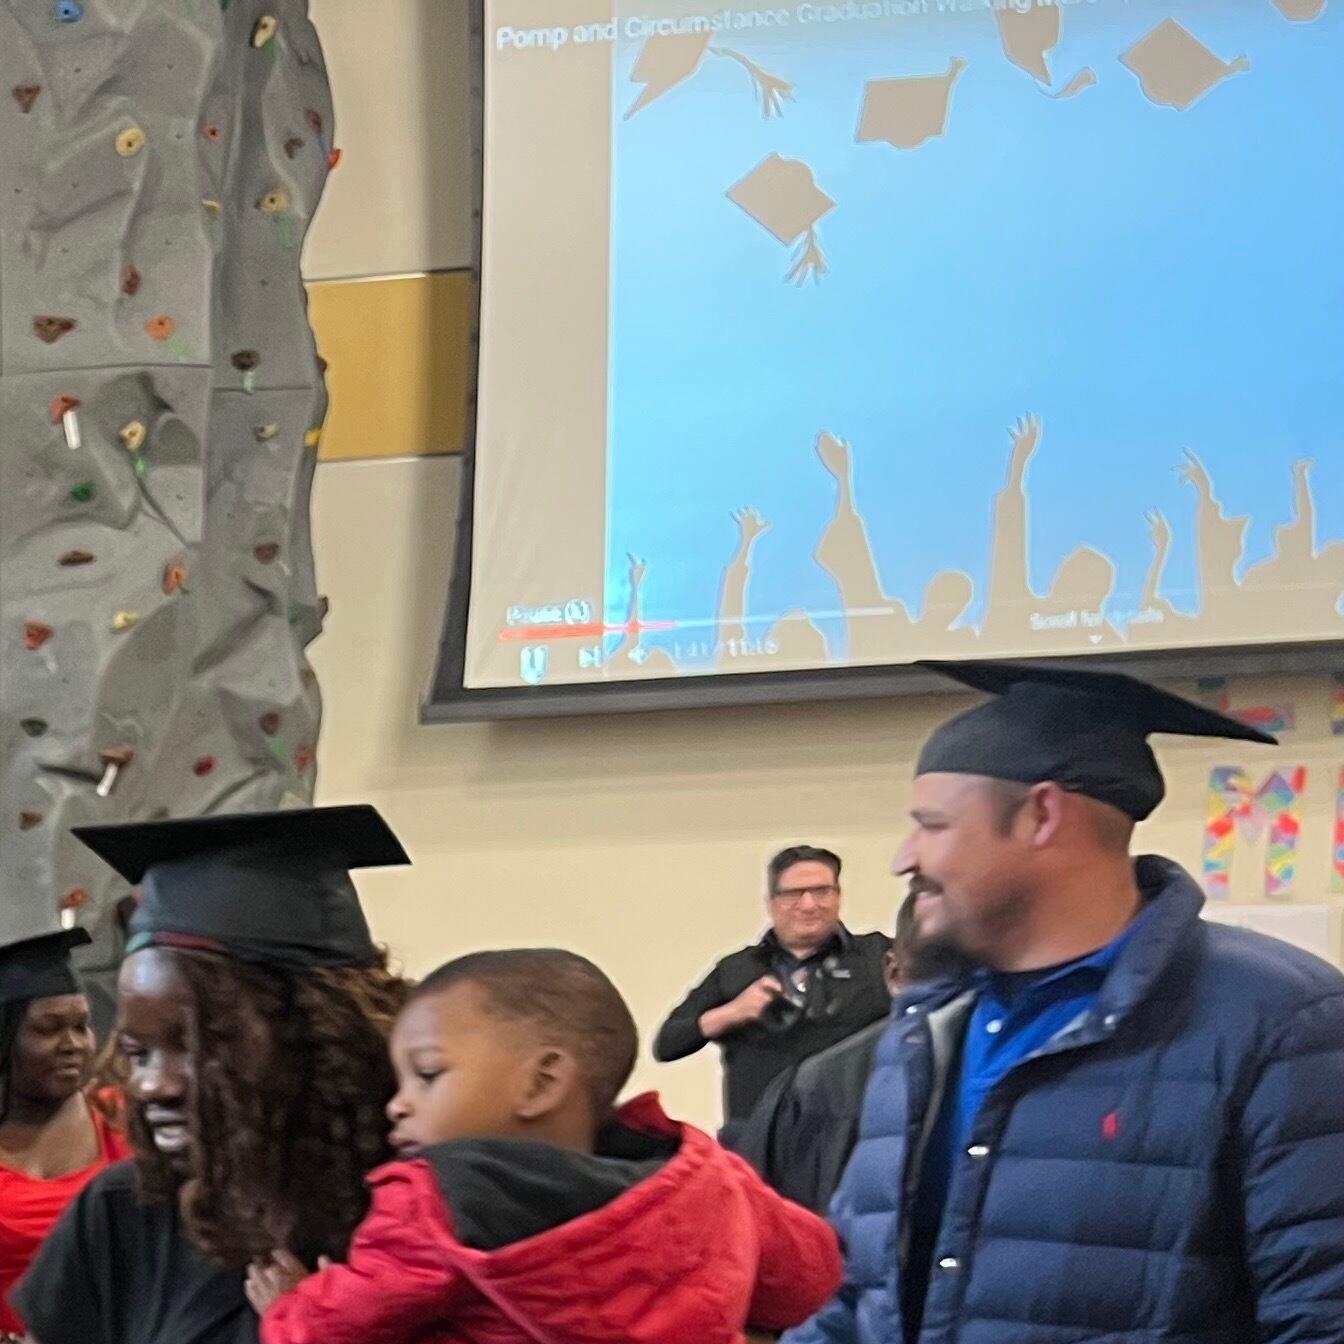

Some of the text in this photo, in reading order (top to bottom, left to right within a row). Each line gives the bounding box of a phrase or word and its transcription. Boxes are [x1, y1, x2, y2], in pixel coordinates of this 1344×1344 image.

[496, 27, 568, 50] Pomp
[573, 18, 618, 42] and
[624, 7, 789, 38] Circumstance
[1203, 765, 1344, 899] M
